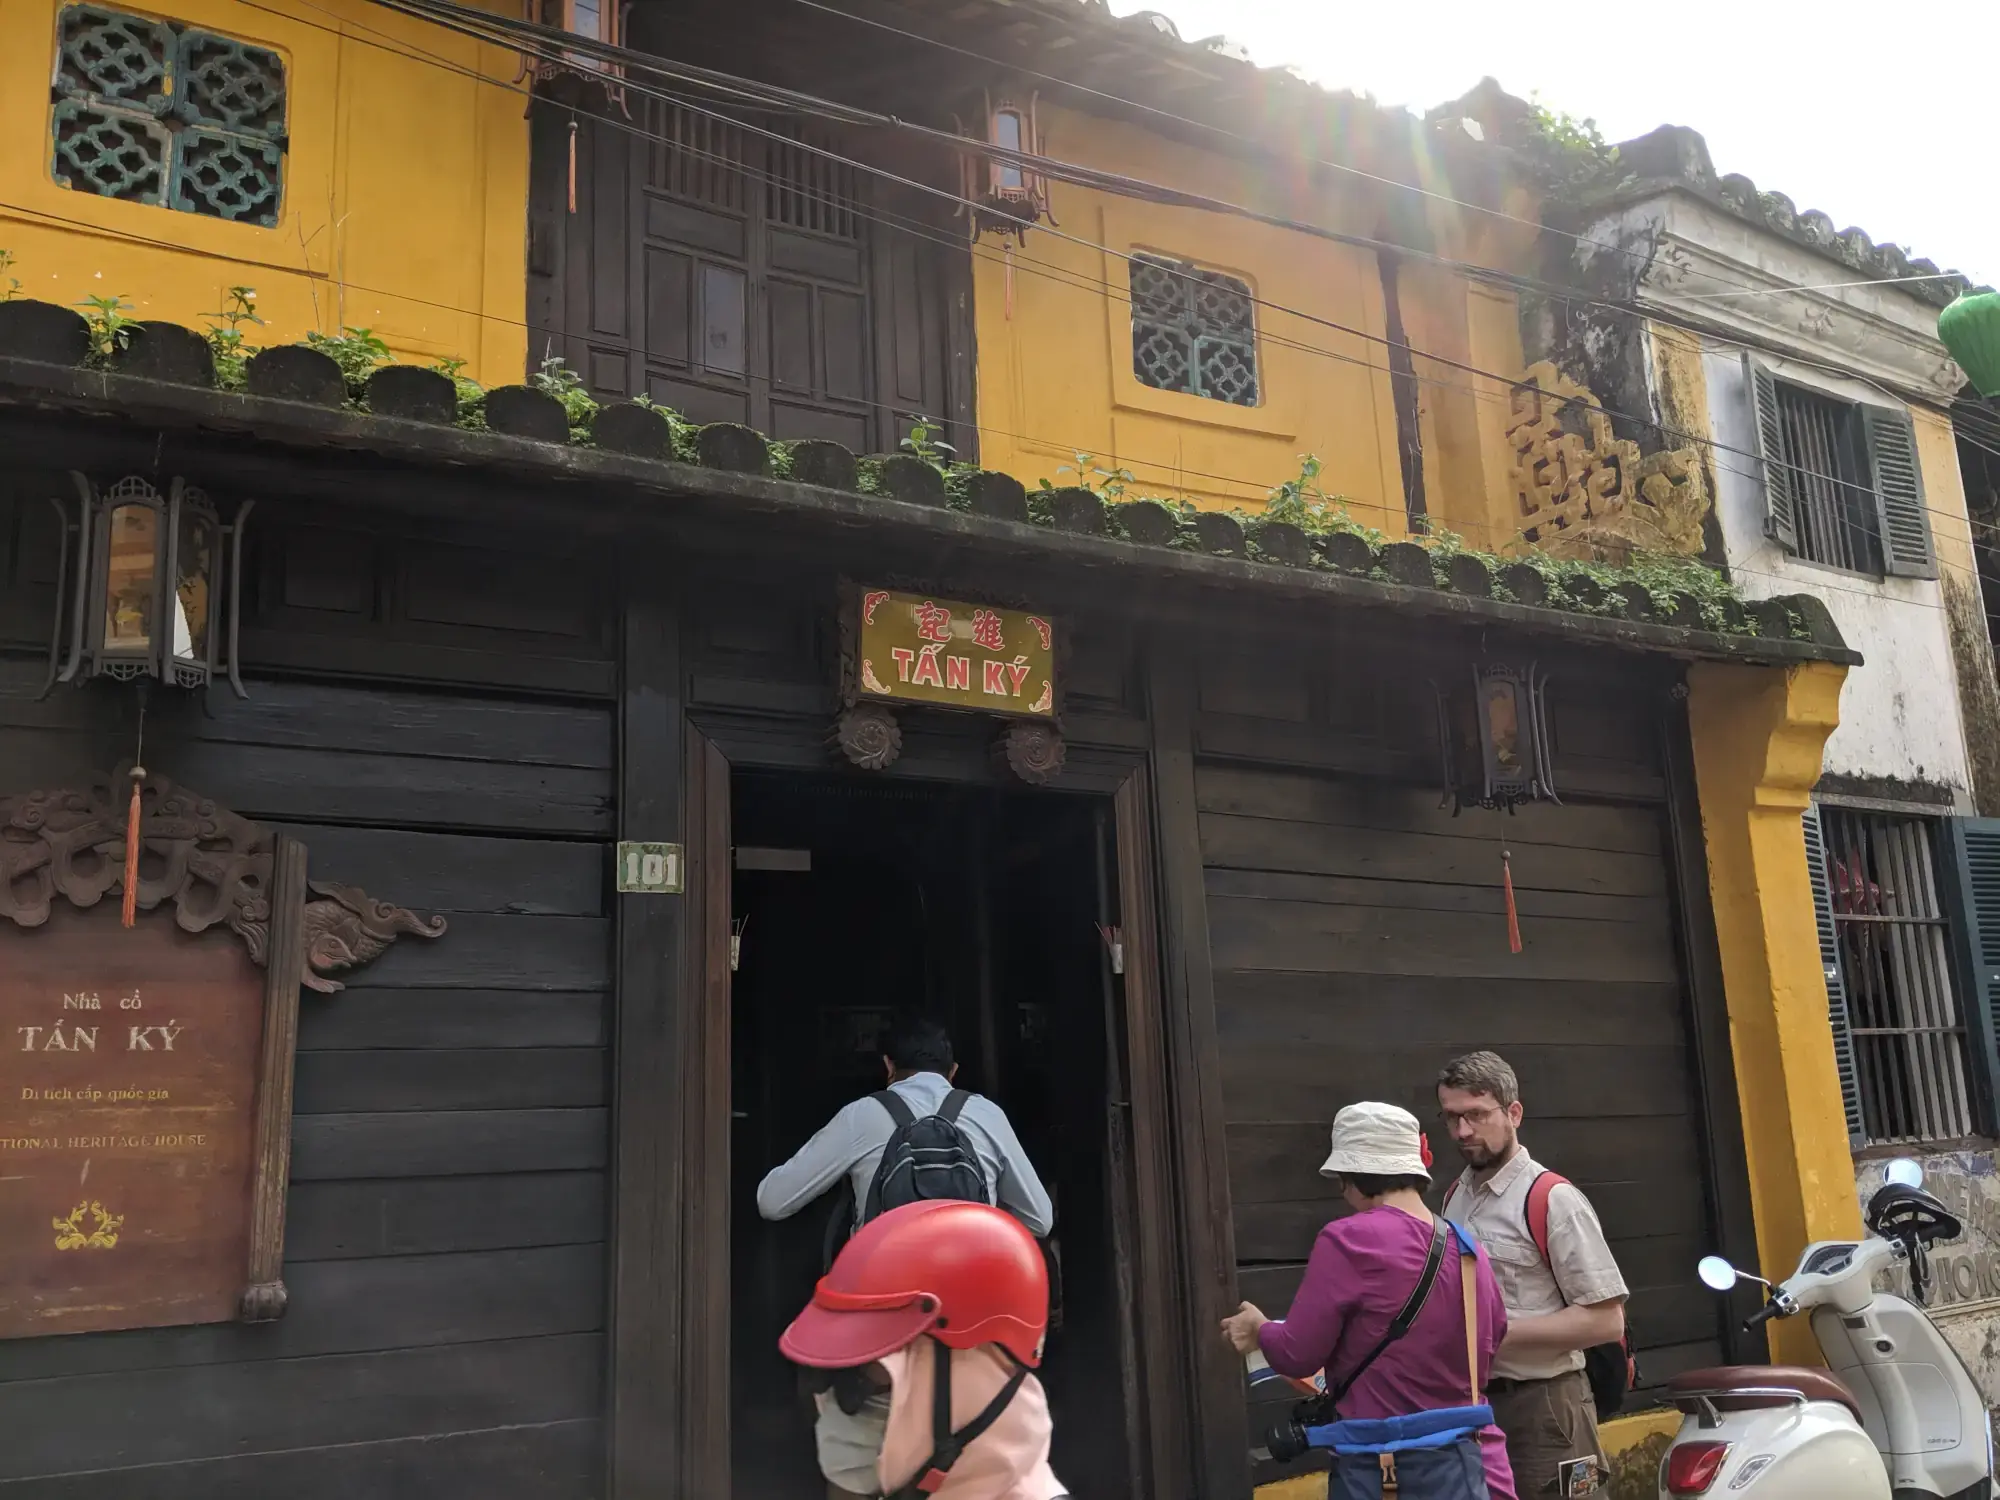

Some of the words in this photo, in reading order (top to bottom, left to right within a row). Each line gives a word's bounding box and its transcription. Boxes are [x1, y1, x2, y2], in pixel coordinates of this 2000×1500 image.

[891, 643, 971, 691] TẤN
[982, 655, 1032, 697] KÝ
[626, 852, 677, 886] 101
[63, 992, 102, 1010] Nhà
[125, 1018, 185, 1052] KÝ
[0, 1137, 63, 1149] TIONAL
[68, 1135, 152, 1148] HERITAGE
[155, 1134, 207, 1147] HOUSE
